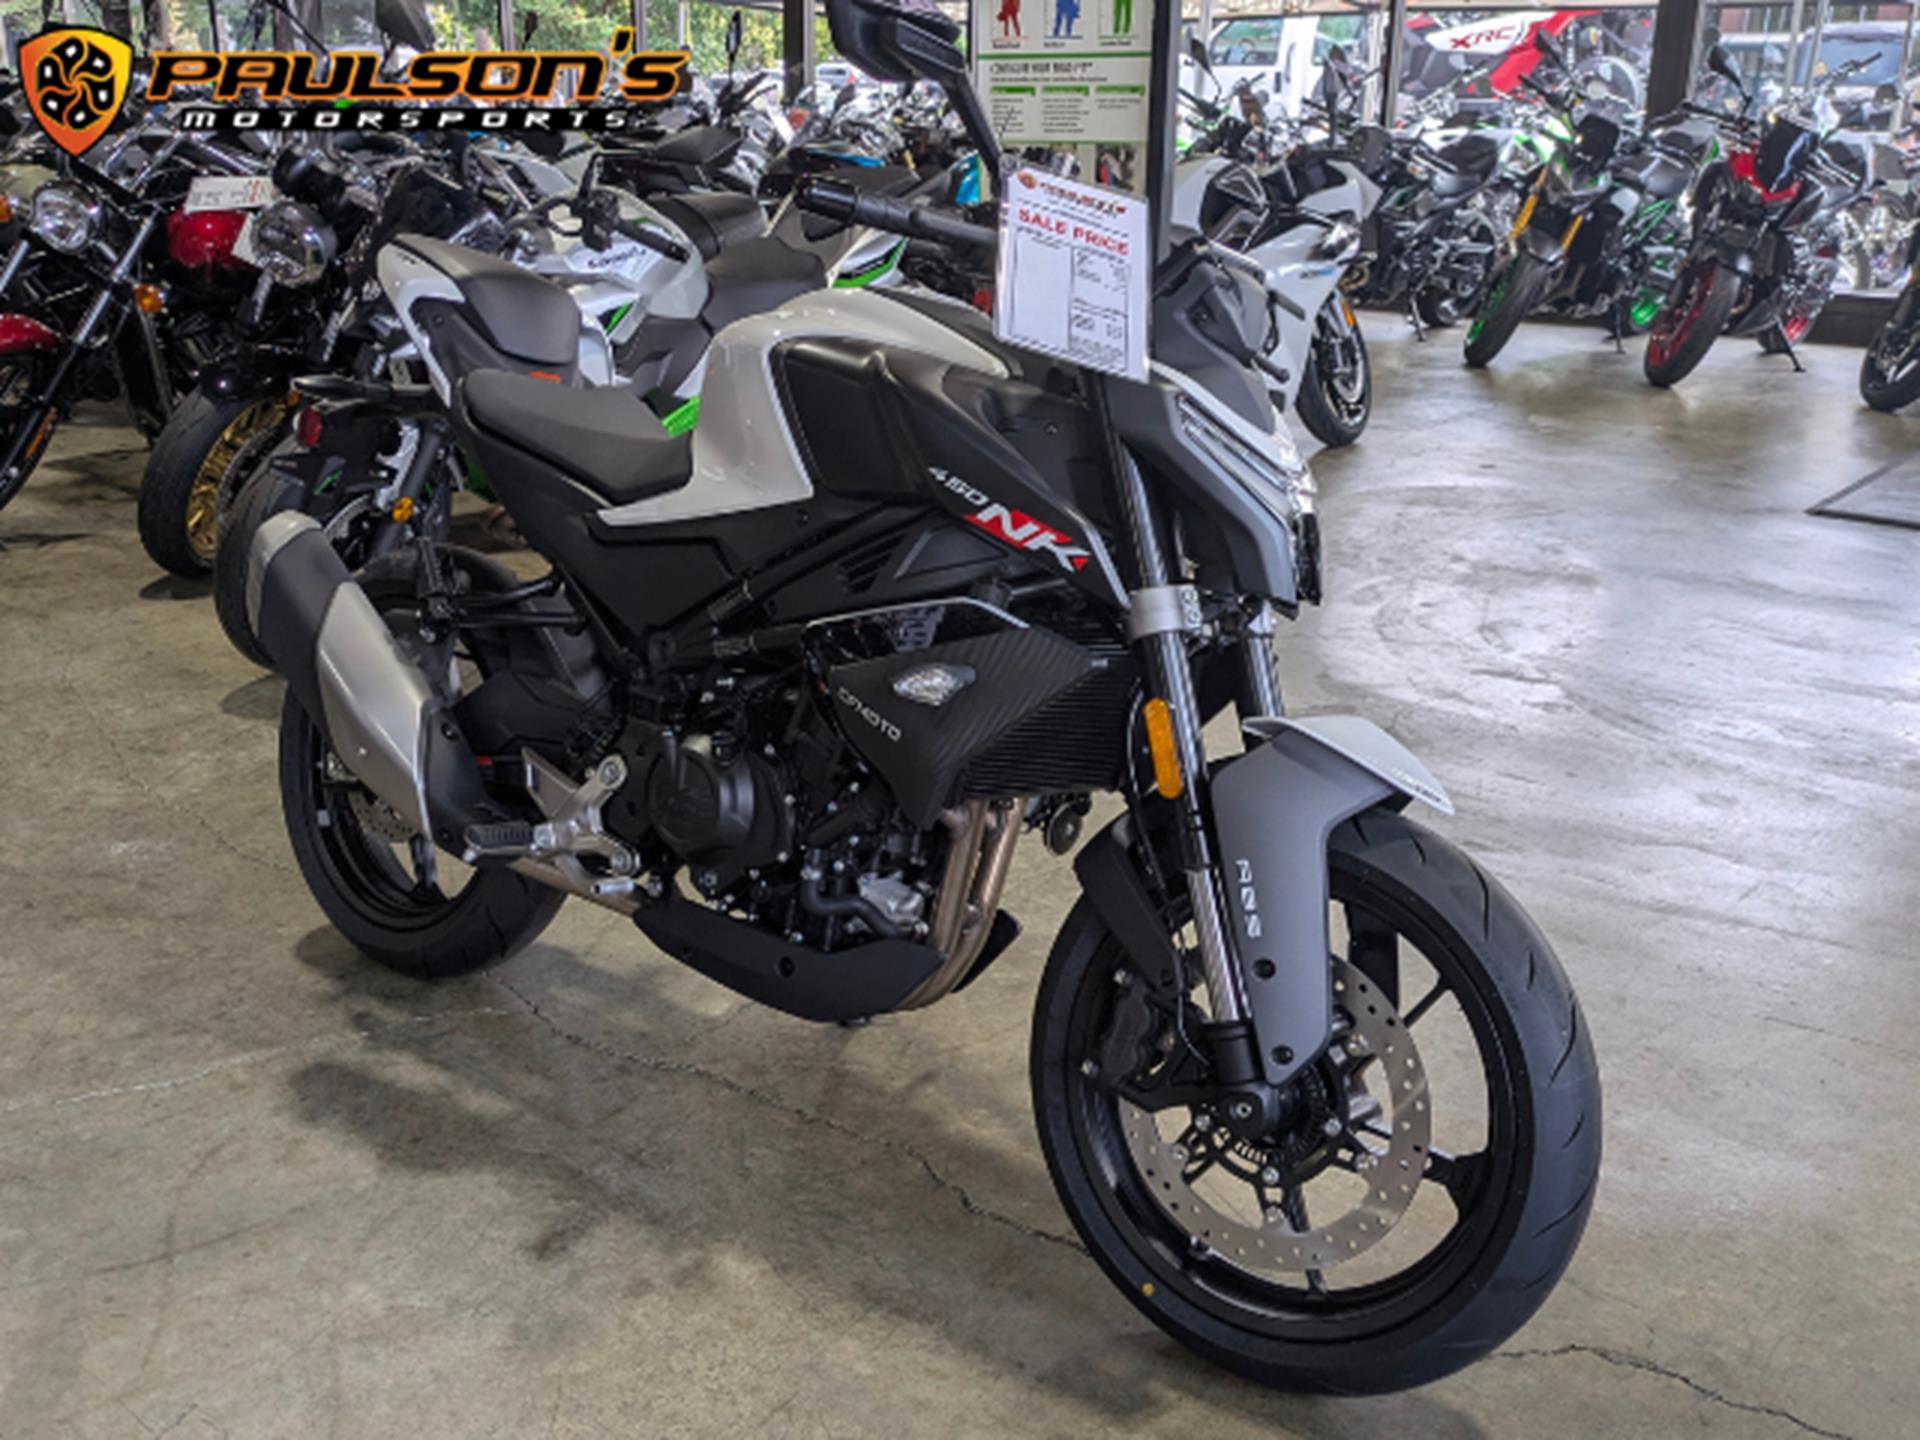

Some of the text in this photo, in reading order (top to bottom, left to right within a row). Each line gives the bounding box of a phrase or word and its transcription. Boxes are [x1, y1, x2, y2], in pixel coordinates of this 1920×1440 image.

[1451, 25, 1516, 49] XRC
[1017, 208, 1067, 236] SALE
[1072, 226, 1130, 257] PRICE
[975, 503, 1091, 573] NK
